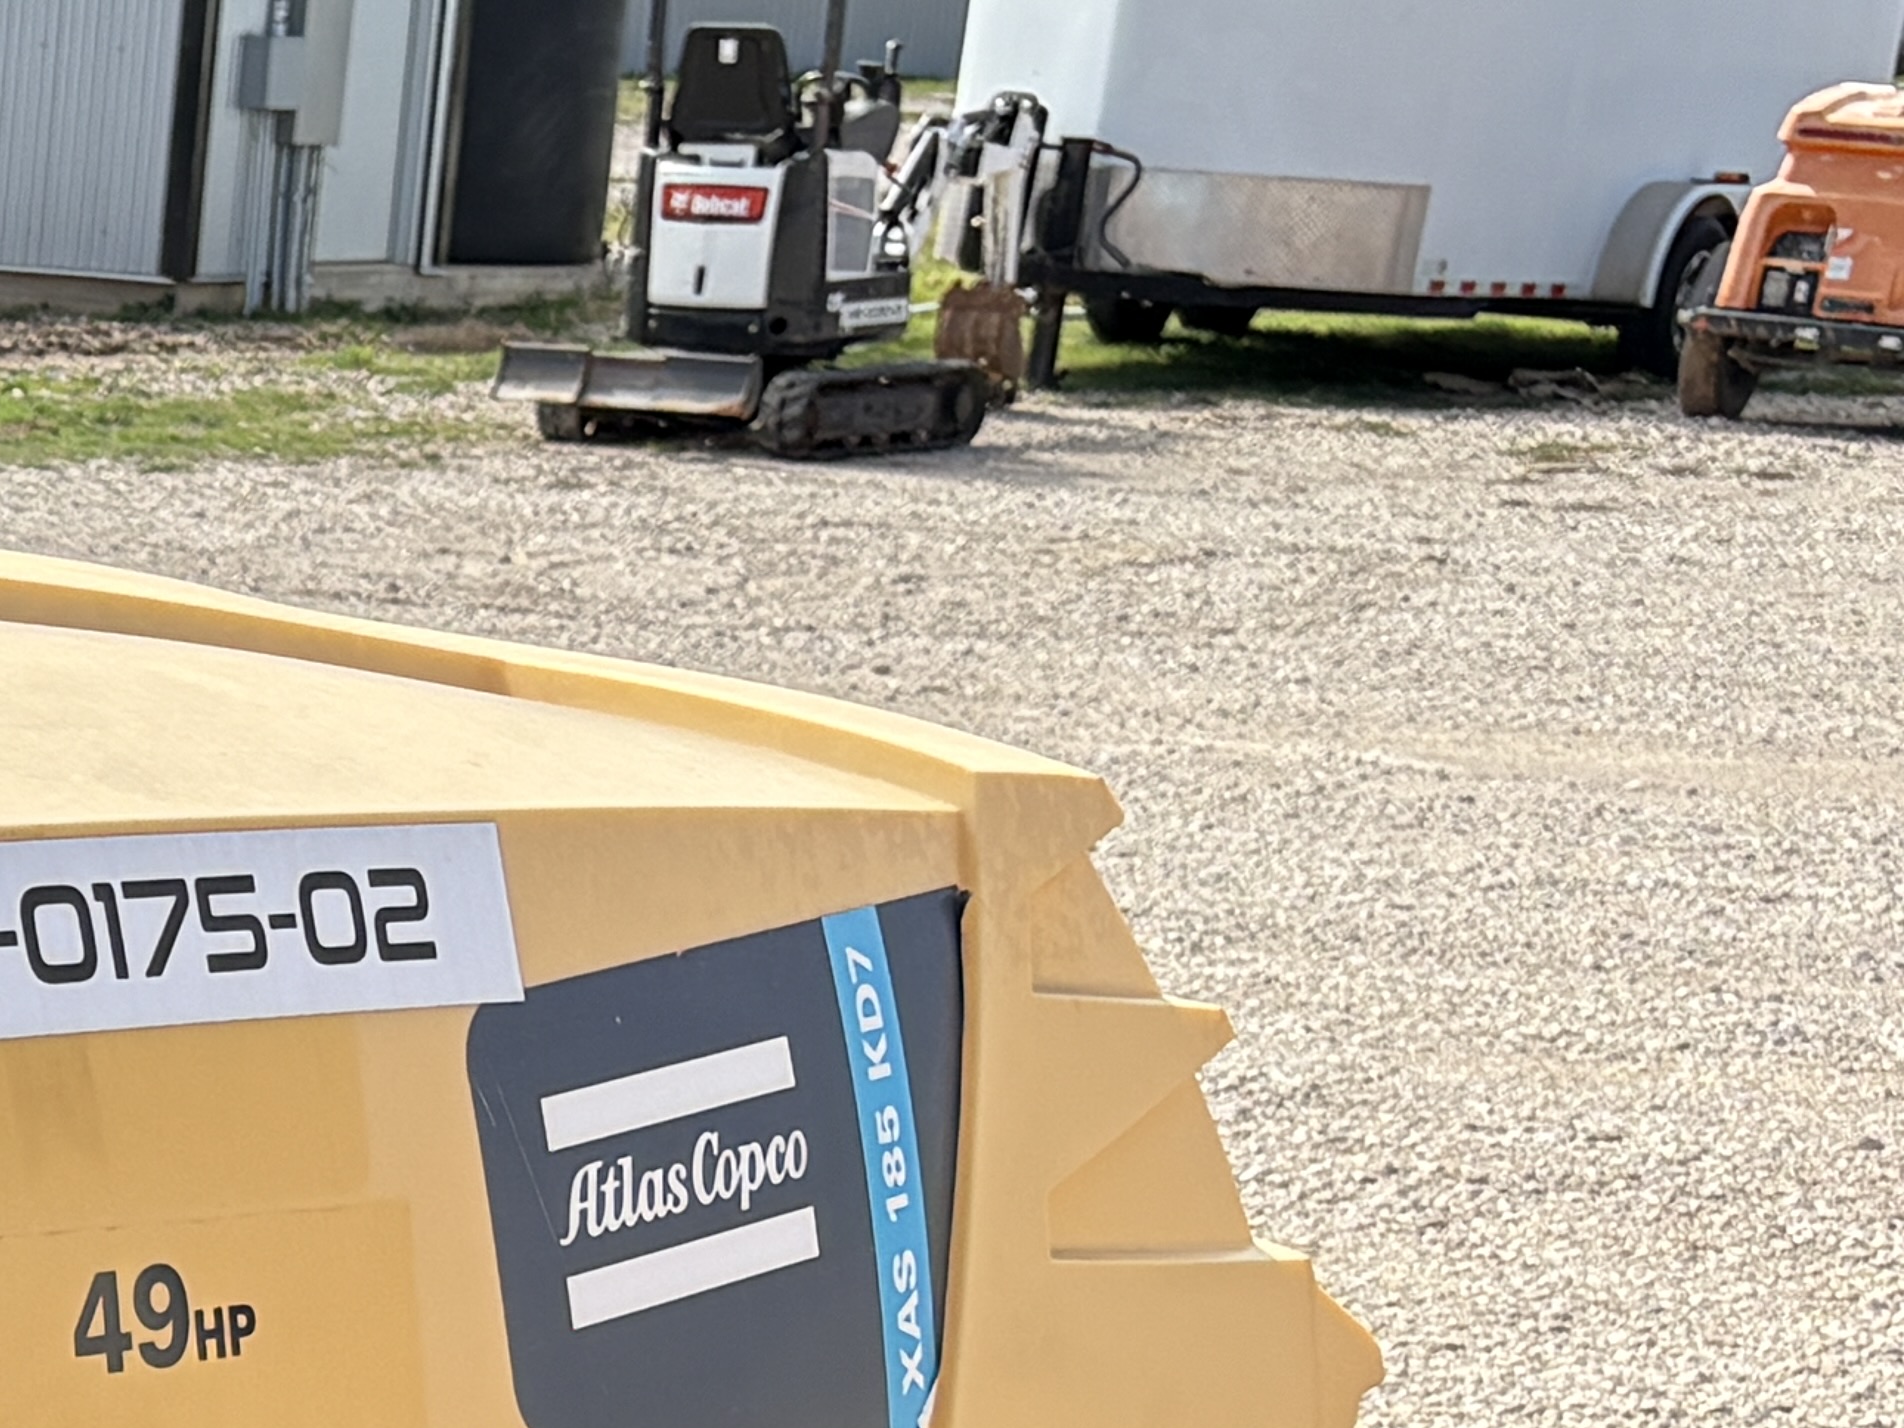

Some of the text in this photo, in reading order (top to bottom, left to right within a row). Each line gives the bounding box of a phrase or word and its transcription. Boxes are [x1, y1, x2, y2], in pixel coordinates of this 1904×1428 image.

[690, 193, 751, 217] Bobcat
[844, 946, 925, 1396] XAS 185 KD7
